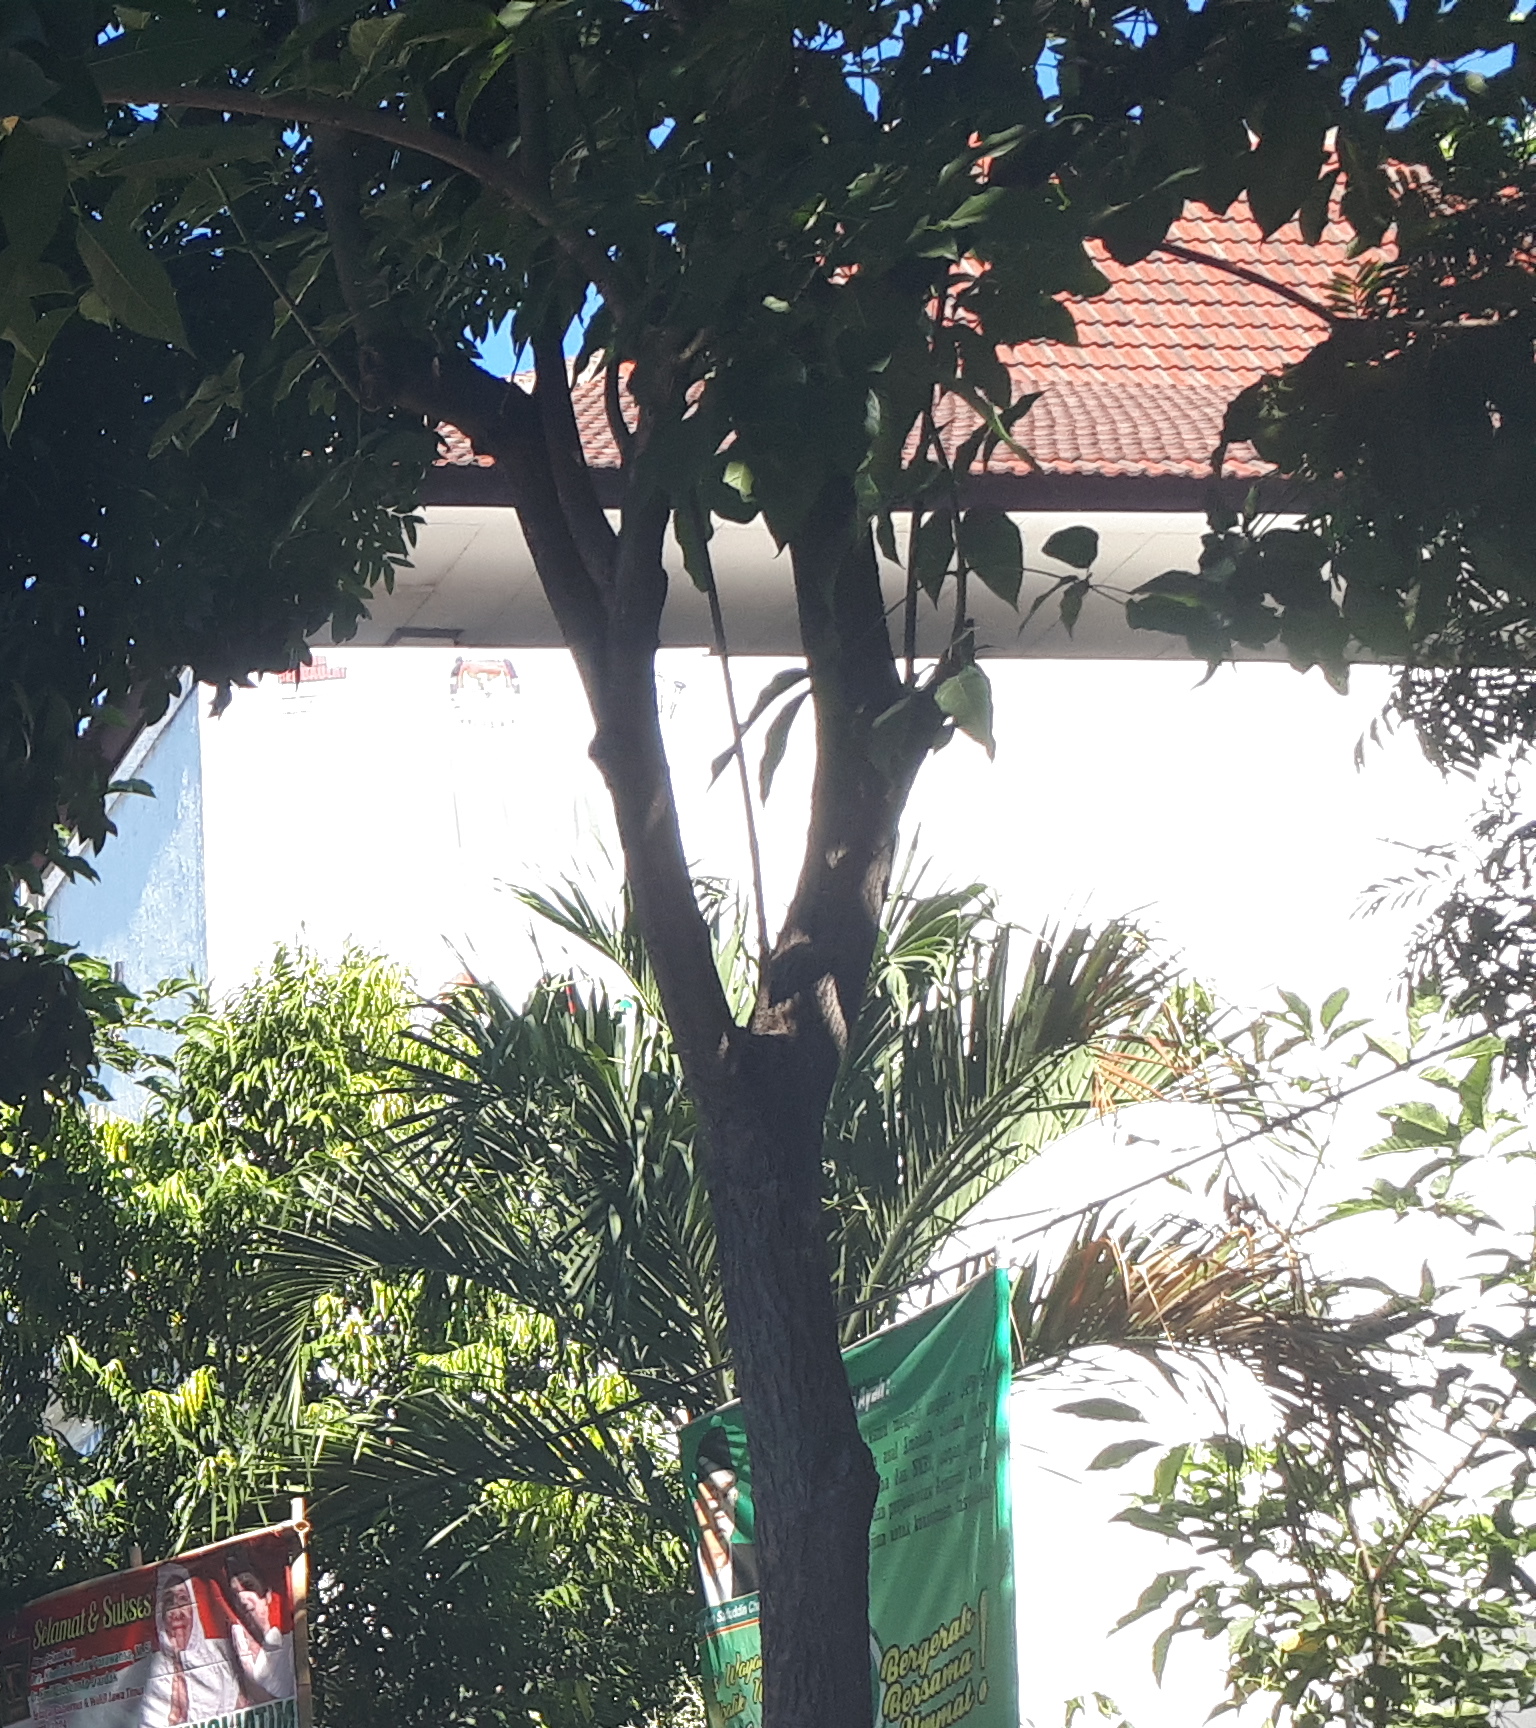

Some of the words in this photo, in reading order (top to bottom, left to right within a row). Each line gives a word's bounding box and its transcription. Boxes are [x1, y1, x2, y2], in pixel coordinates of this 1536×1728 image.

[33, 1607, 86, 1650] Selamat
[87, 1600, 100, 1633] &
[102, 1593, 153, 1628] Sukses
[880, 1602, 976, 1685] Bergerak
[882, 1647, 975, 1723] Bersama
